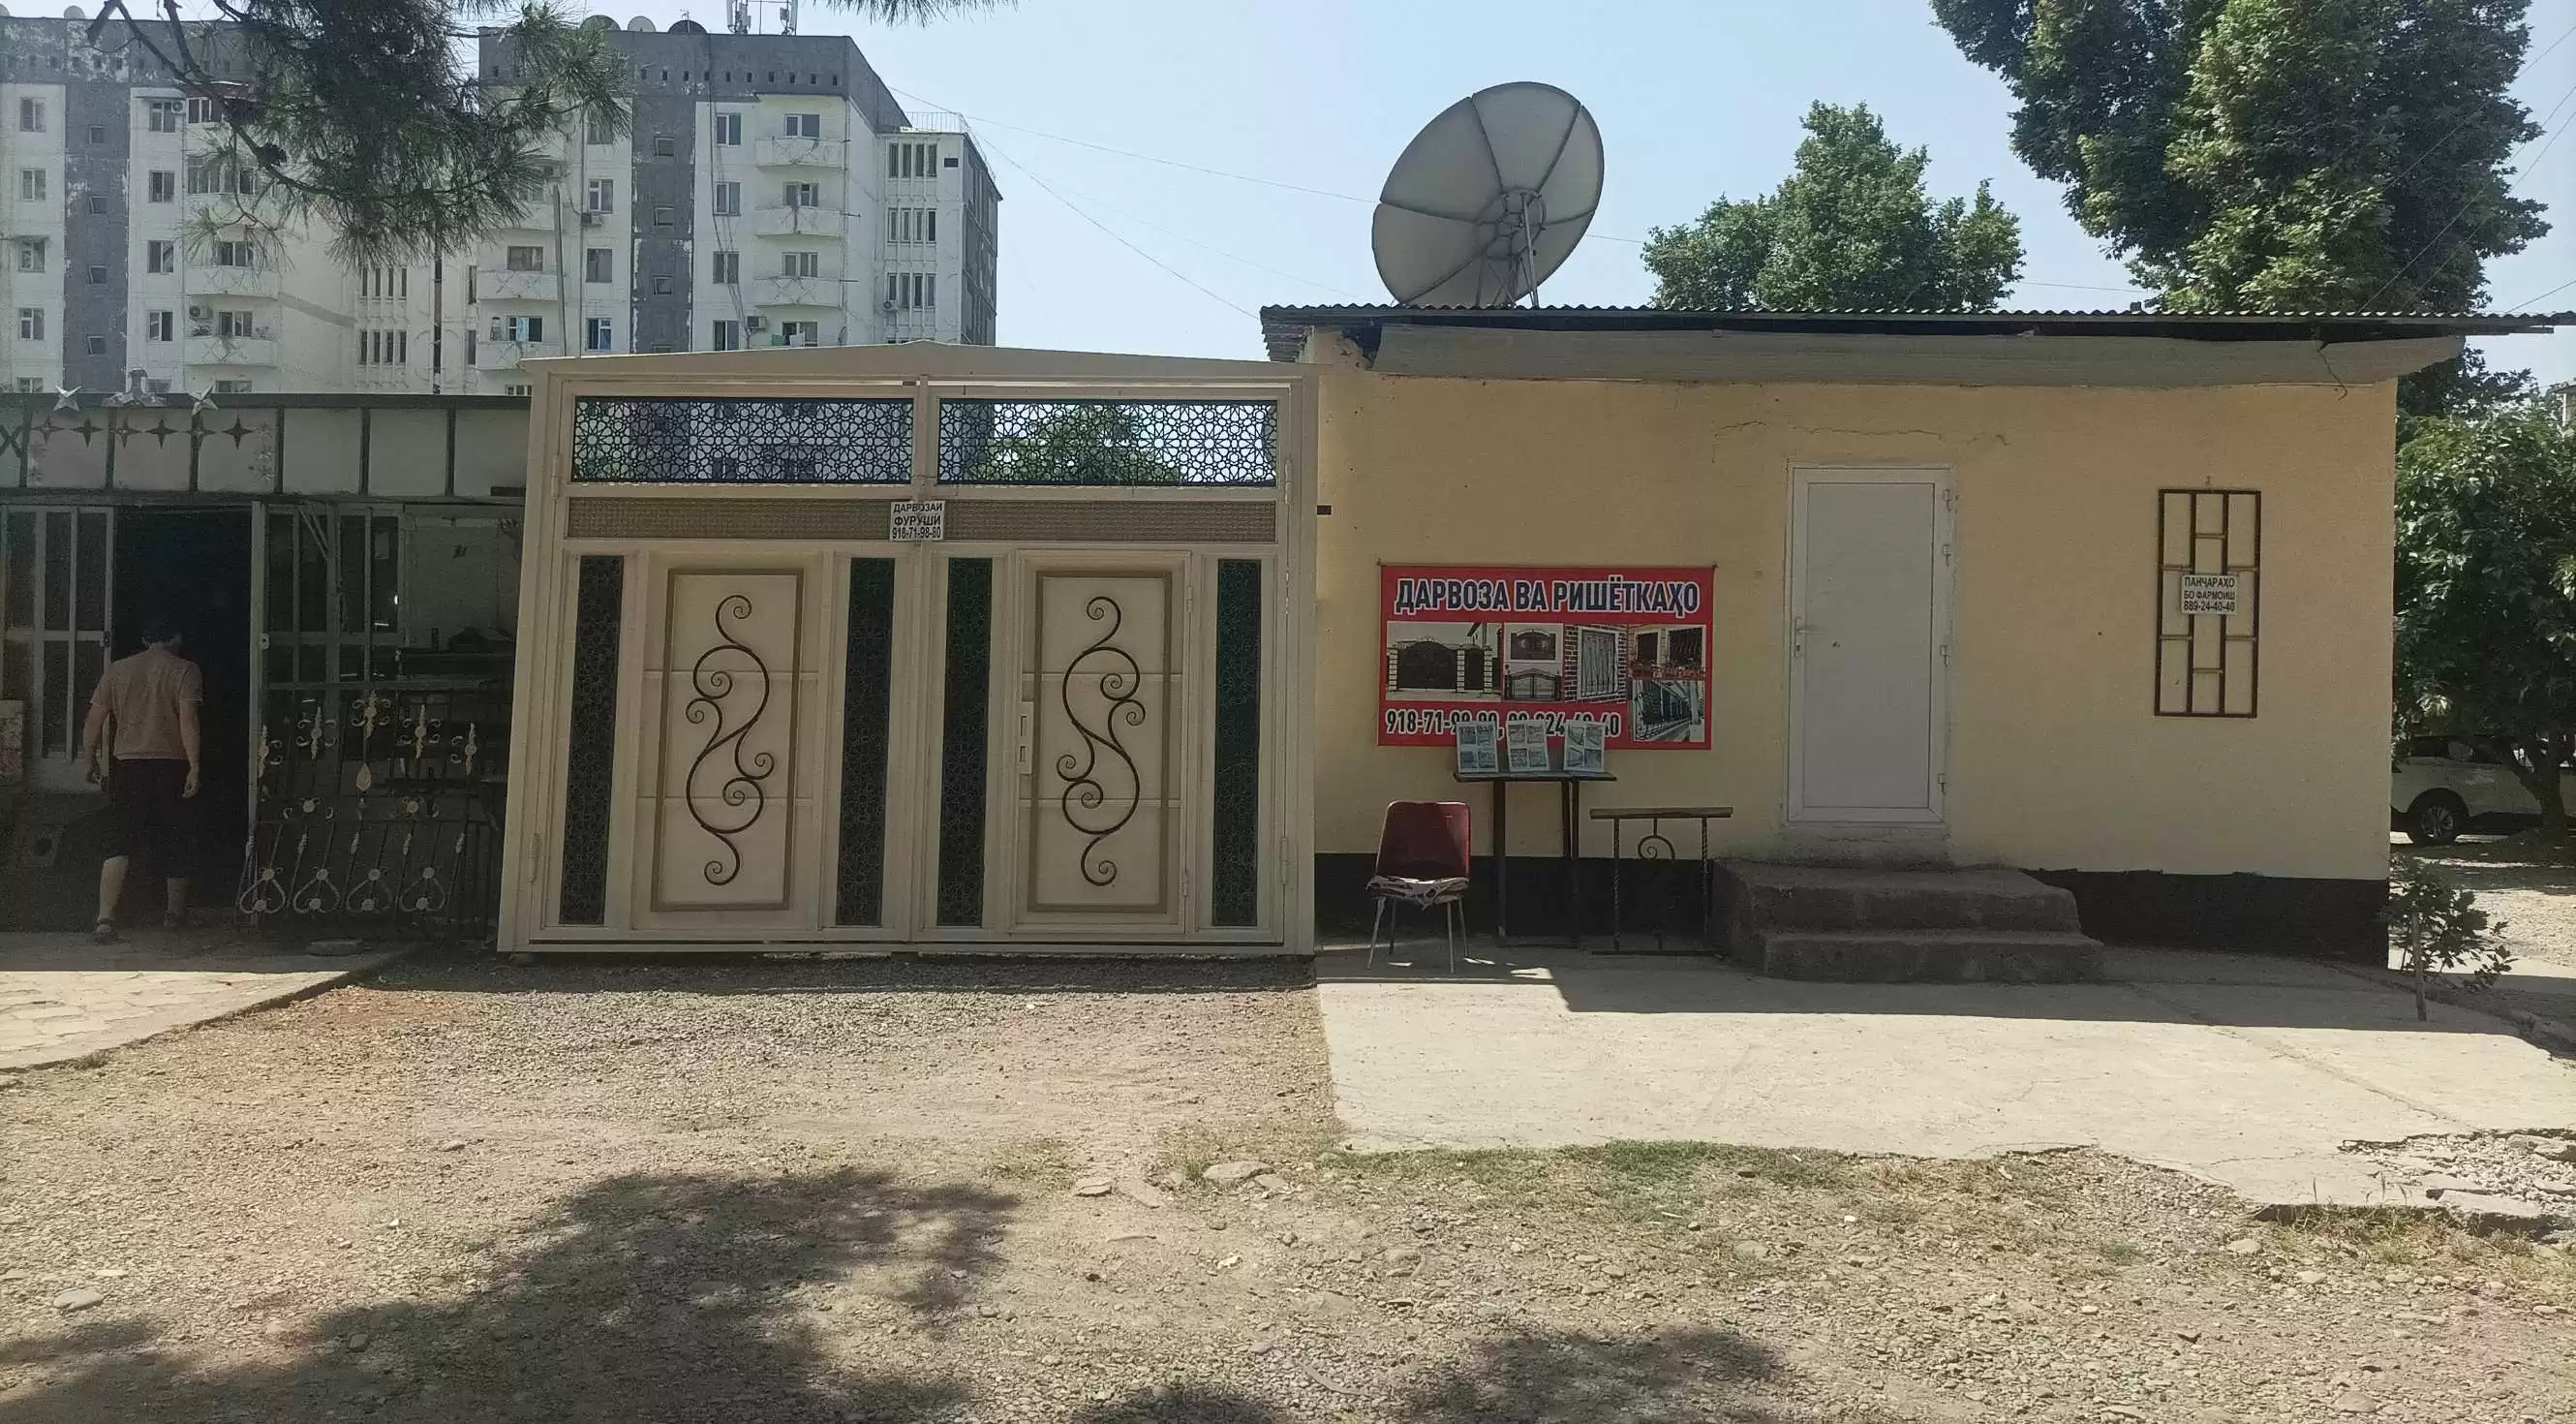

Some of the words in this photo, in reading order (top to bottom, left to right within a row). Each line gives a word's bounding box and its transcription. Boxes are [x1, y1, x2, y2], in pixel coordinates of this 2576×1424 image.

[1395, 578, 1511, 615] ДАРВОЗА
[1514, 579, 1549, 612] ВА
[1551, 574, 1700, 618] РИШЁТКАҲО
[2184, 590, 2194, 600] БО
[2184, 601, 2235, 611] 889-24-40-40
